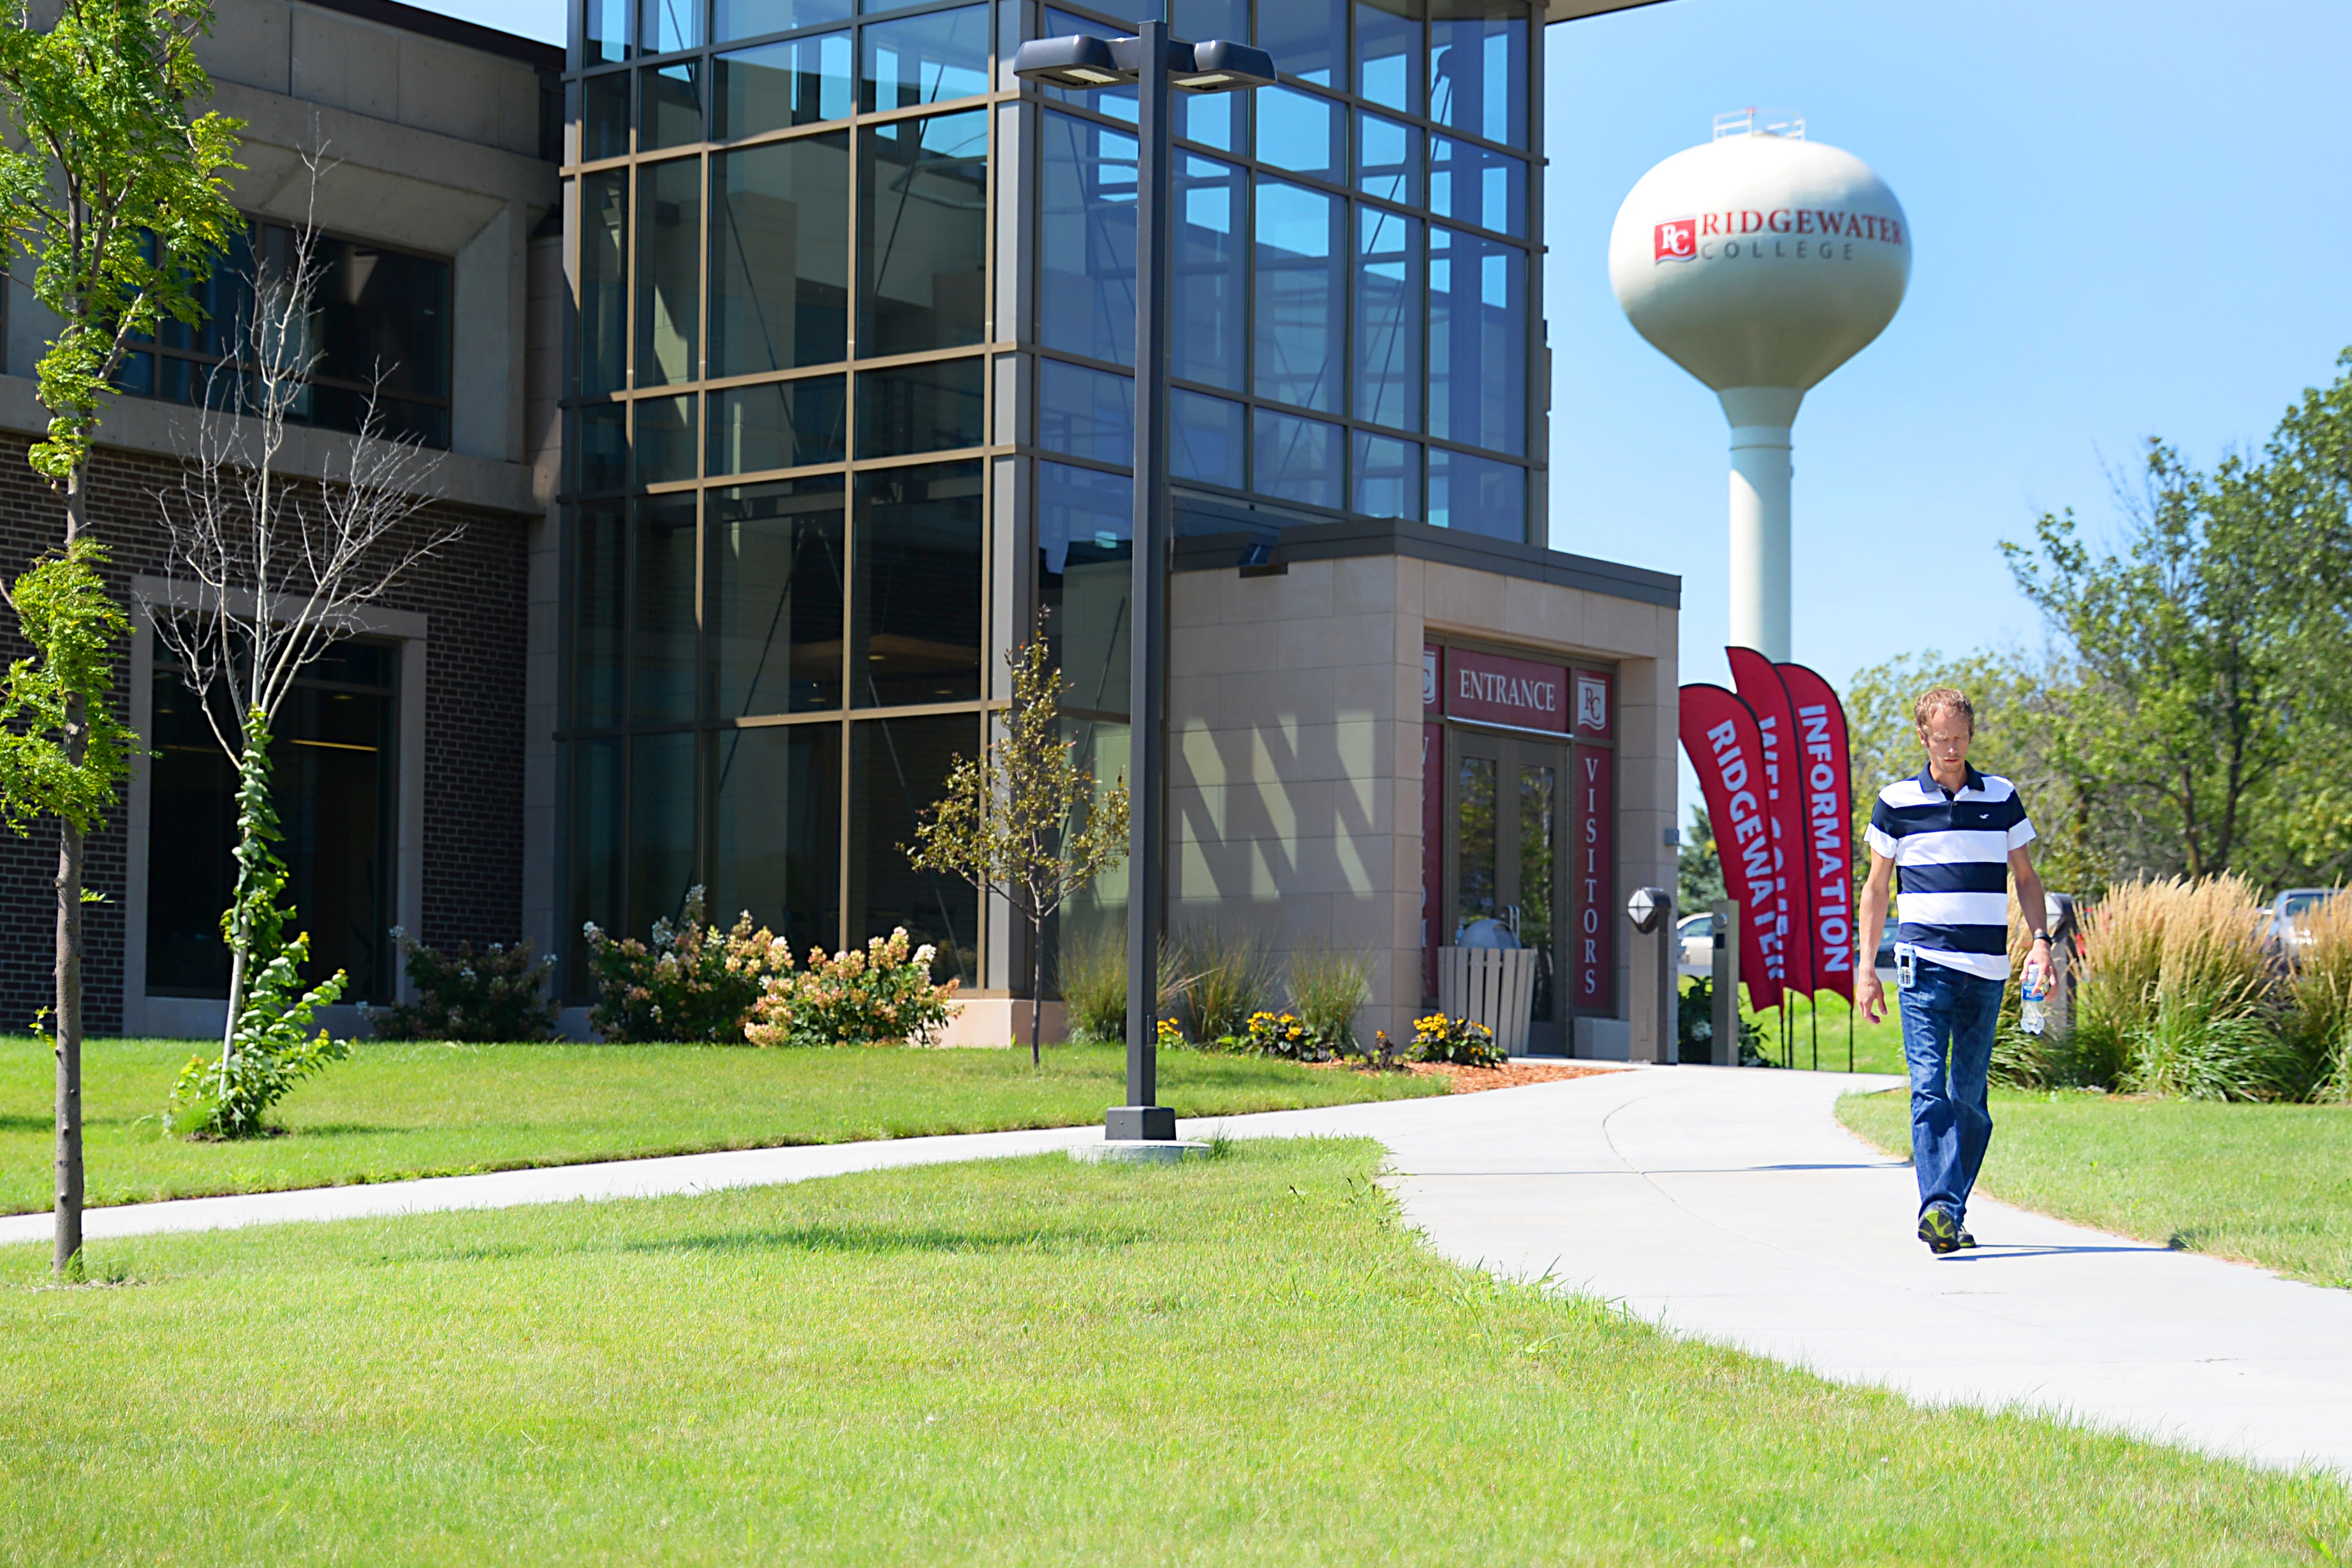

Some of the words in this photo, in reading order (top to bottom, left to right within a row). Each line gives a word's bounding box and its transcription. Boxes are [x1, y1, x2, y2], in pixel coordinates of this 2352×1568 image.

[1702, 209, 1903, 245] RIDGEWATER
[1701, 240, 1854, 260] COLLEGE
[1459, 669, 1555, 712] ENTRANCE
[1798, 705, 1849, 973] INFORMATION
[1584, 757, 1599, 995] VISITORS
